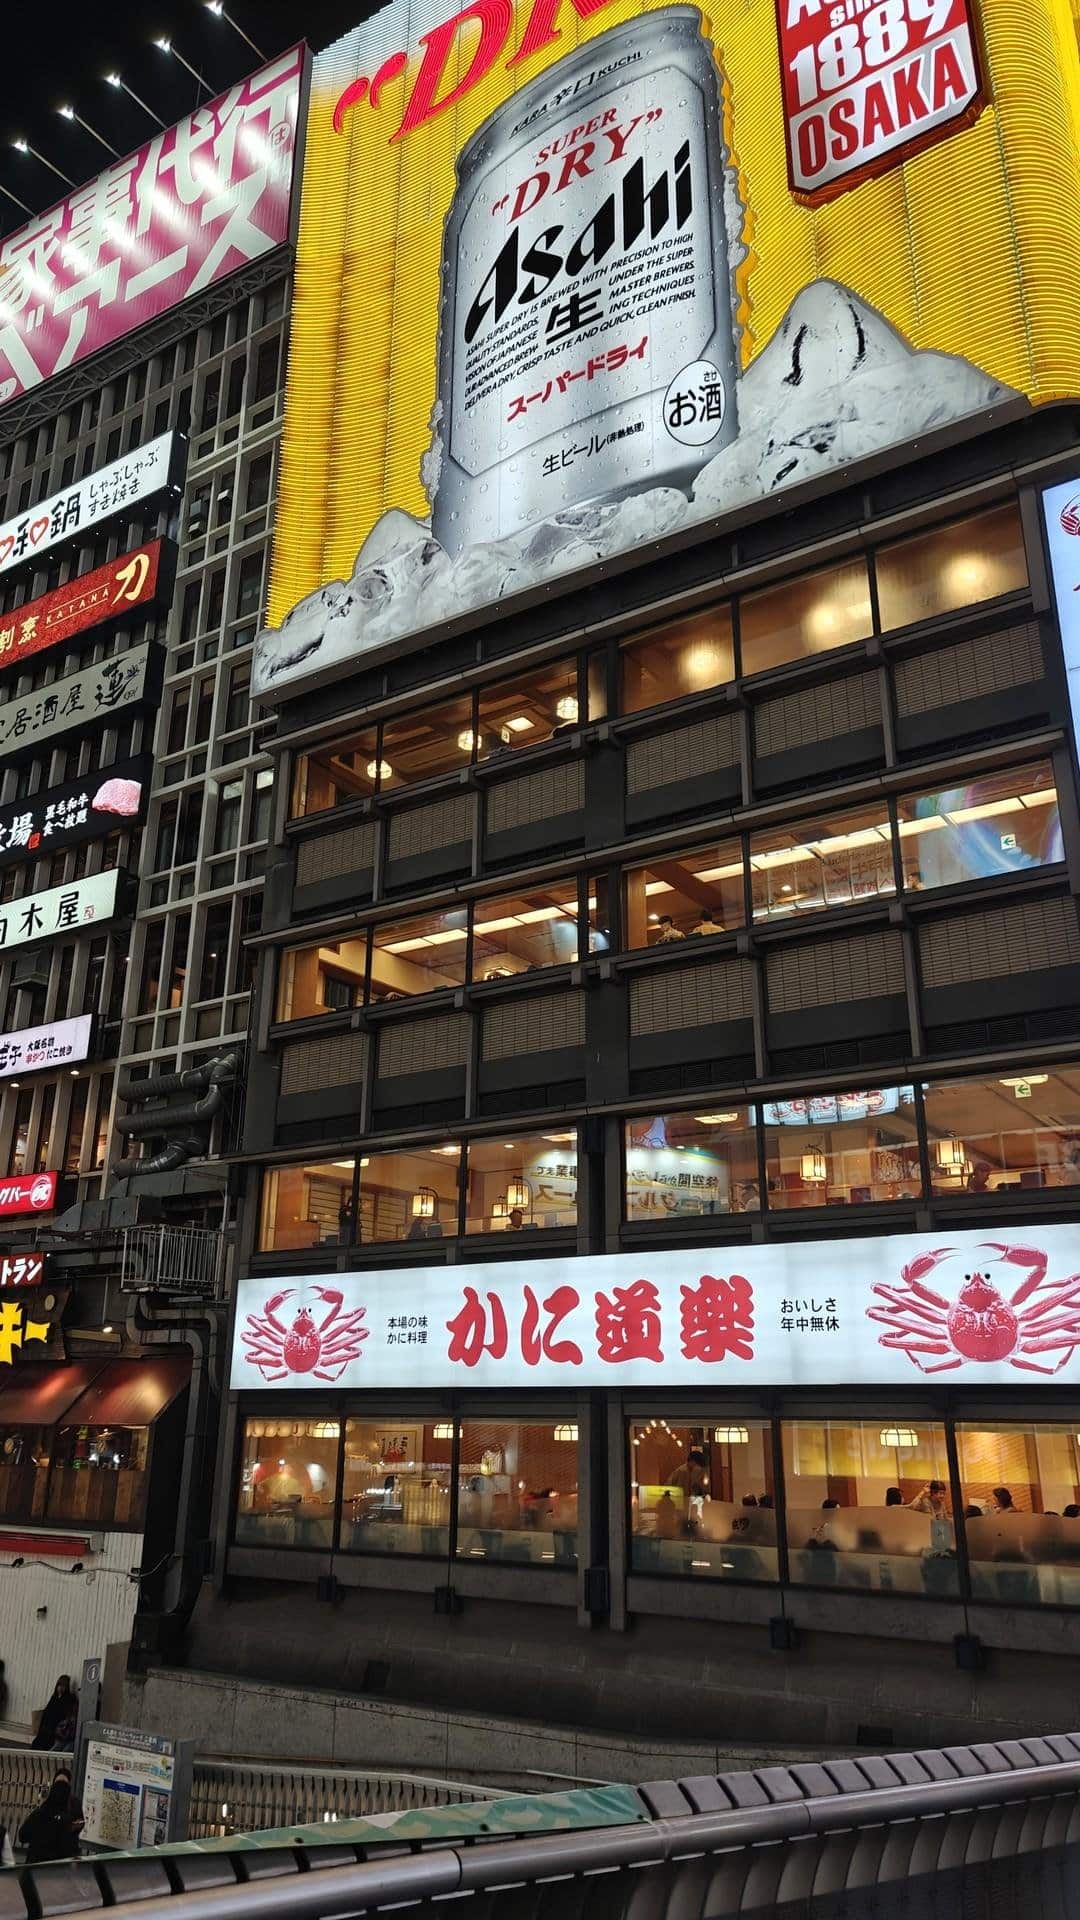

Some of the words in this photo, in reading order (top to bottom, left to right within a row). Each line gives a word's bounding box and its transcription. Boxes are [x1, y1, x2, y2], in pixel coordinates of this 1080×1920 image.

[511, 103, 548, 137] KARA
[598, 51, 642, 78] KUCHI
[797, 40, 969, 178] OSAKA
[535, 107, 617, 168] SUPER
[463, 138, 693, 345] Asahi
[486, 321, 510, 344] SUPER
[511, 307, 530, 326] DRY
[530, 302, 539, 314] IS
[540, 279, 580, 309] BREWED
[581, 265, 609, 286] WITH
[610, 243, 660, 272] PRECISION
[661, 238, 673, 251] TO
[673, 231, 694, 245] HIGH
[608, 262, 645, 287] UNDER
[646, 255, 666, 270] THE
[608, 274, 652, 301] MASTER
[608, 297, 631, 315] ING
[631, 274, 696, 304] TECHNIQUES
[545, 287, 604, 346] 生
[464, 385, 491, 412] DELIVER
[517, 354, 543, 376] CRISP
[544, 337, 574, 361] TASTE
[574, 325, 599, 346] AND
[636, 296, 668, 316] CLEAN
[465, 364, 486, 384] VISION
[486, 354, 497, 369] OF
[497, 329, 539, 362] JAPANESE
[465, 346, 492, 371] QUALITY
[464, 382, 478, 398] OUR
[478, 358, 514, 388] ADVANCED
[507, 335, 649, 421] スーパードライ
[702, 370, 718, 383] さけ
[668, 382, 722, 428] お酒
[89, 445, 161, 499] しゃぶしゃぶ
[87, 478, 141, 518] すき焼き
[110, 553, 150, 608] 刀
[46, 587, 110, 625] KATANA
[43, 807, 88, 837] 食べ放題
[45, 792, 90, 820] 黒毛和牛
[387, 1314, 429, 1330] 本場の味
[780, 1297, 837, 1314] おいしさ
[780, 1315, 840, 1332] 年中無休
[387, 1330, 428, 1345] かに料理
